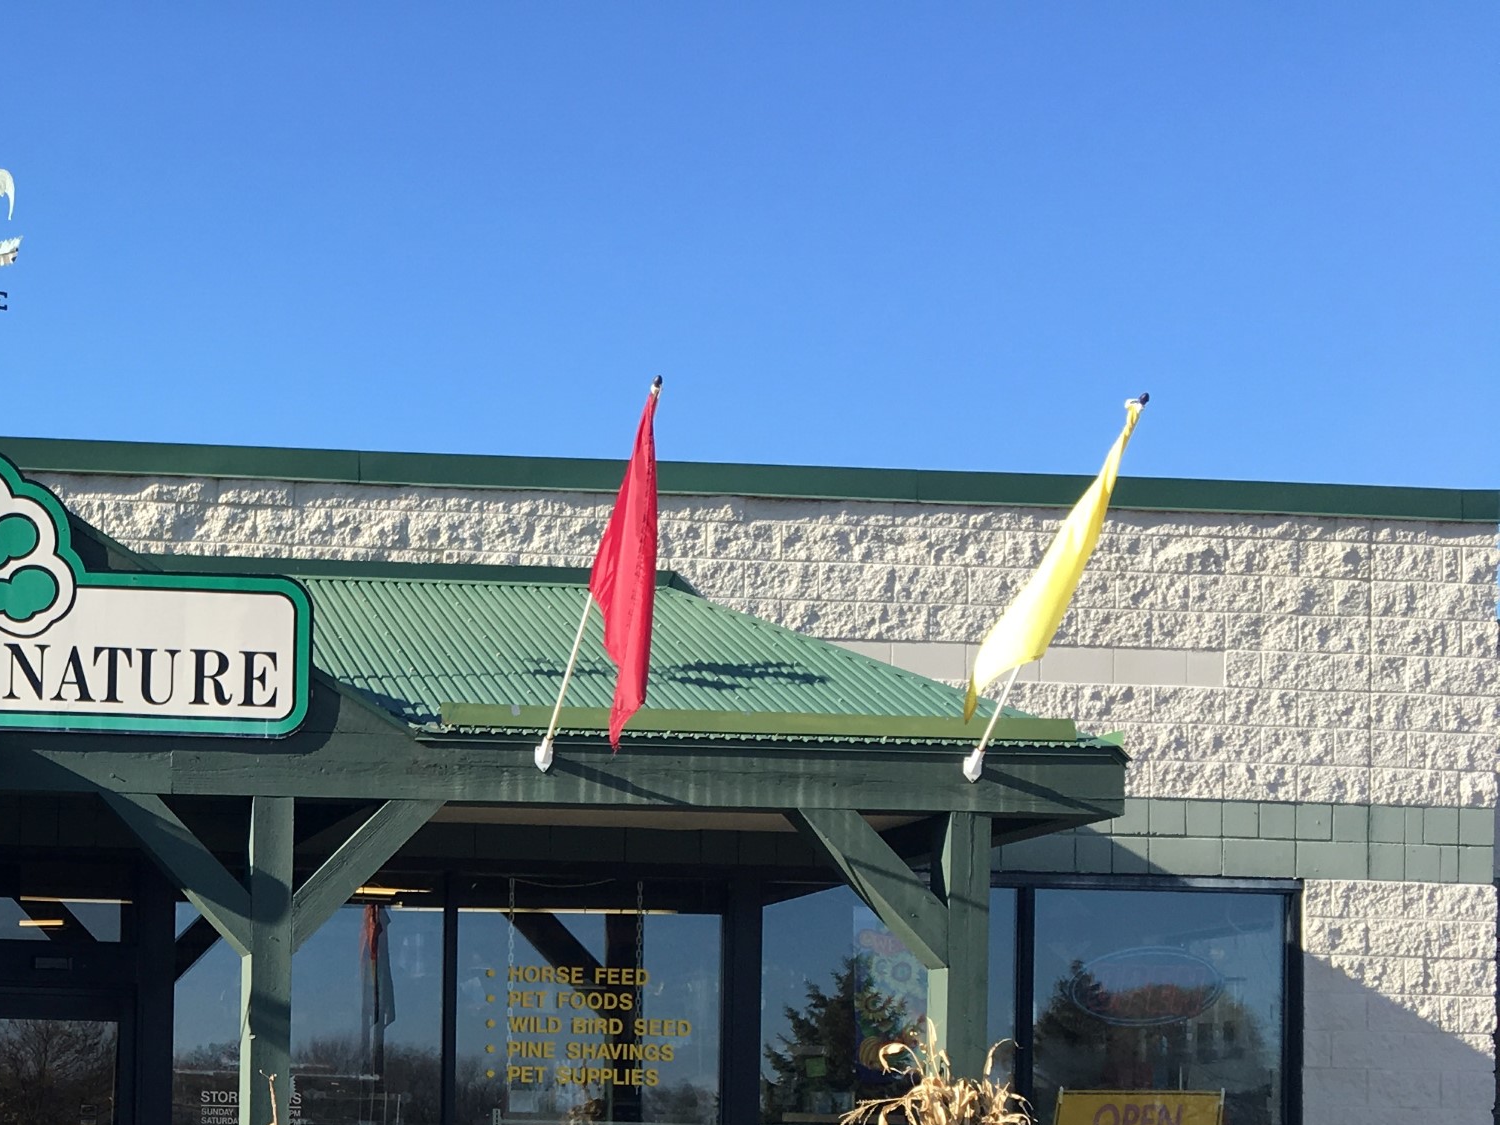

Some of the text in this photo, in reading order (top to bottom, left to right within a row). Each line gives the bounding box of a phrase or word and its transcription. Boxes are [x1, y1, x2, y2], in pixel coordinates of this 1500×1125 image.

[3, 643, 280, 709] NATURE
[508, 966, 649, 986] HORSE FEED
[508, 991, 633, 1011] PET FOODS
[509, 1017, 692, 1037] WILD BIRD SEED
[507, 1041, 675, 1062] PINE SHAVINGS
[507, 1066, 660, 1087] PET SUPPLIES
[200, 1090, 238, 1104] STOR
[201, 1108, 234, 1116] SUNDAY
[201, 1117, 238, 1125] SATURDA
